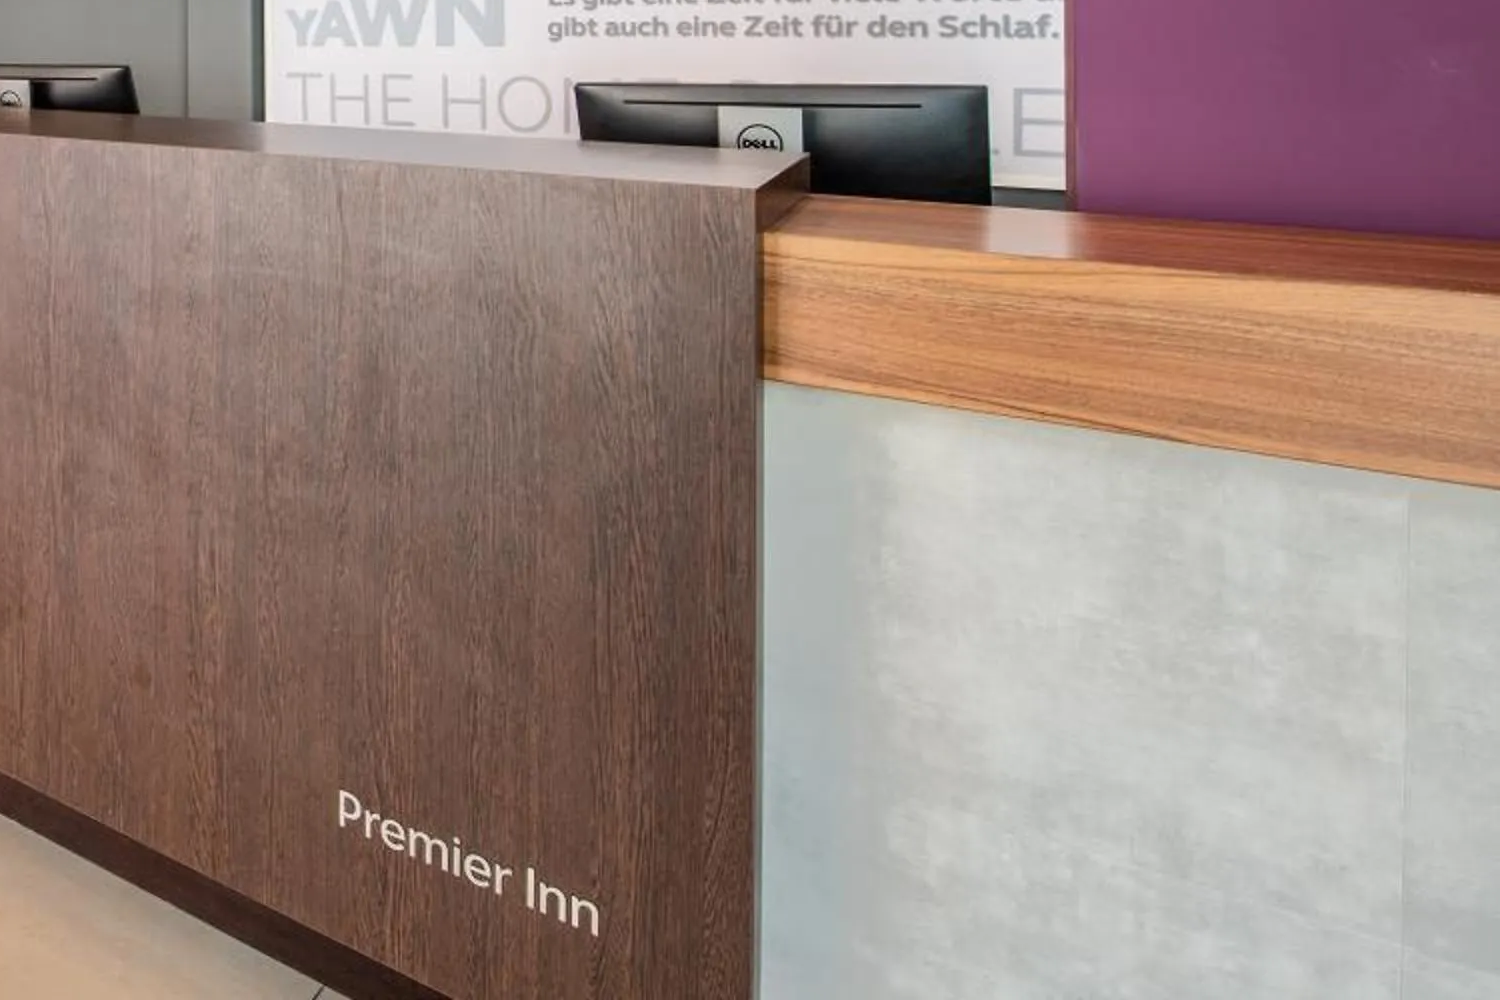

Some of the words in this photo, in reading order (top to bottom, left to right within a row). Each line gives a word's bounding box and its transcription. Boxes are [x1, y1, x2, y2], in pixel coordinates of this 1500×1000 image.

[547, 16, 598, 43] gibt
[605, 16, 670, 38] auch
[676, 16, 737, 38] eine
[743, 15, 804, 38] Zeit
[811, 14, 859, 39] für
[867, 14, 929, 39] den
[938, 13, 1060, 39] Schlaf.
[285, 72, 416, 127] THE
[742, 138, 778, 150] DELL
[338, 789, 513, 896] Premier
[525, 866, 599, 938] Inn
